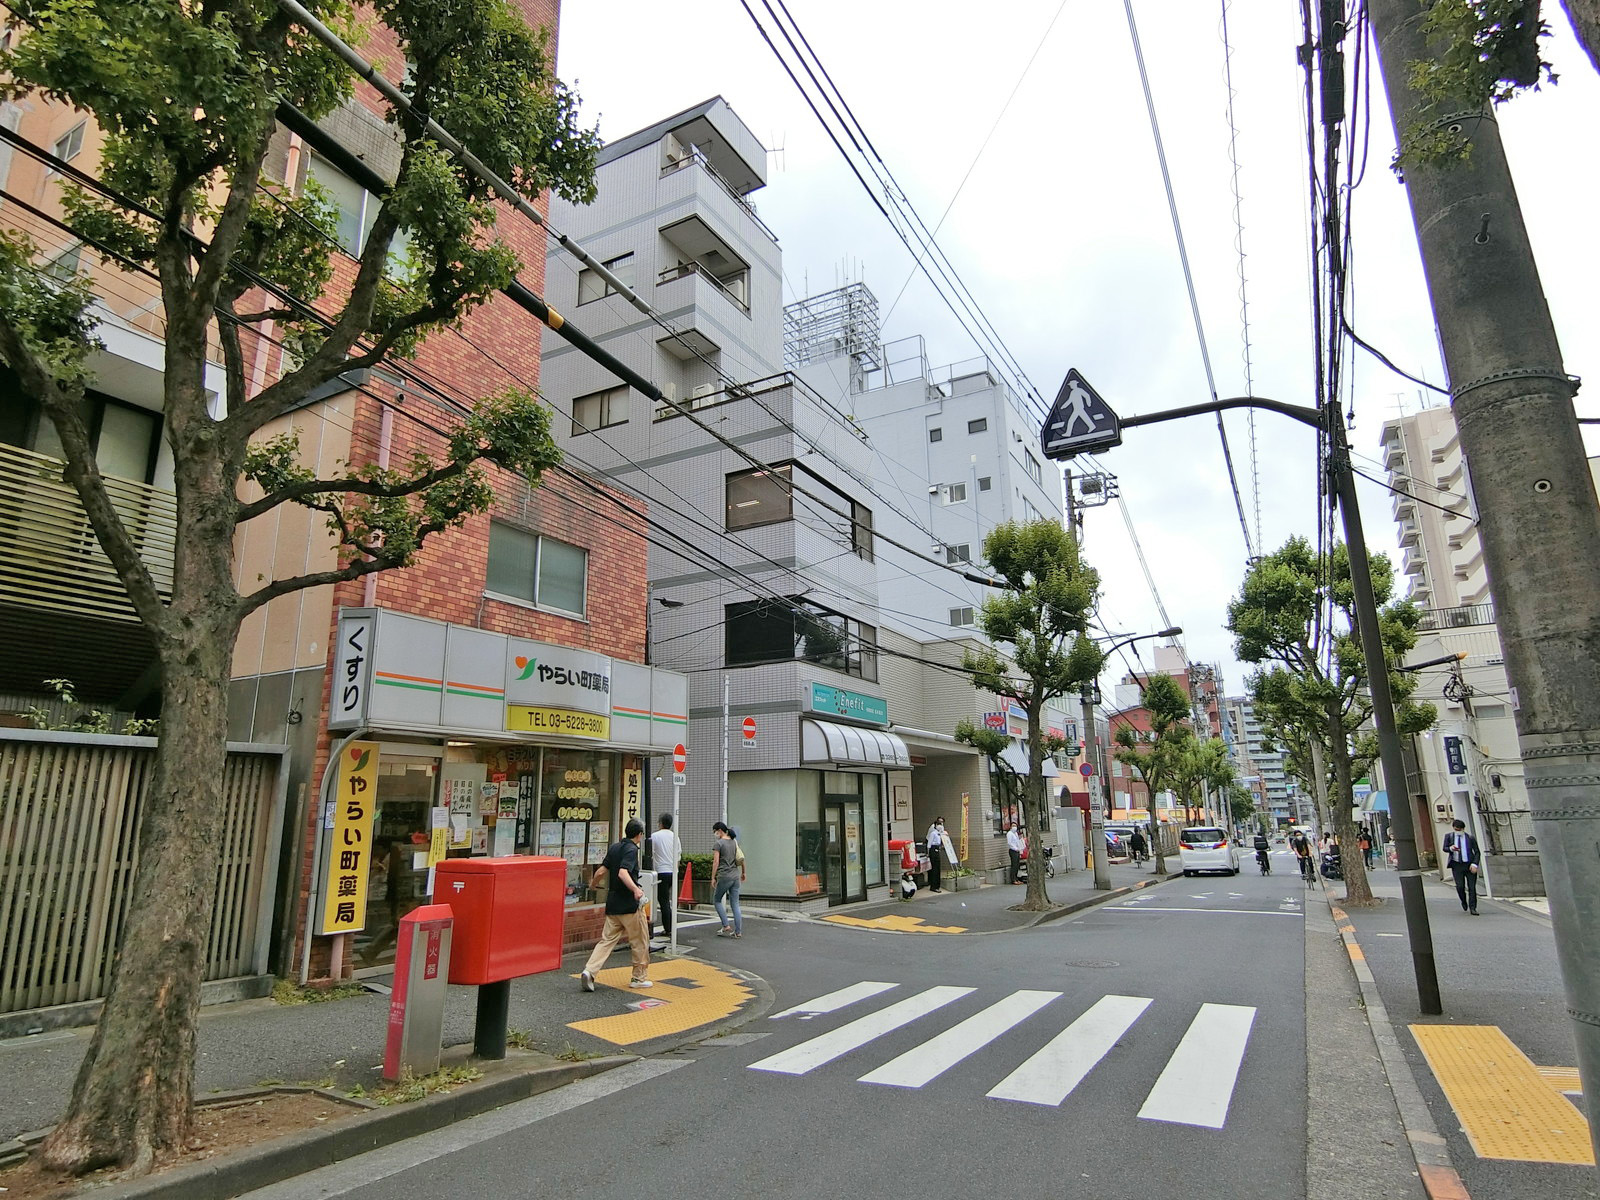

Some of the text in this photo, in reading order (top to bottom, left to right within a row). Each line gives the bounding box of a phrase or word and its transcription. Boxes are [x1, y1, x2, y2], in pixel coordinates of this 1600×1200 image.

[342, 626, 365, 712] くすり
[537, 663, 610, 695] やらい町薬局
[528, 711, 603, 733] TEL 03-5228-3800
[841, 695, 865, 711] Enefit
[335, 775, 368, 925] やらい町薬局
[427, 931, 439, 975] 消火器
